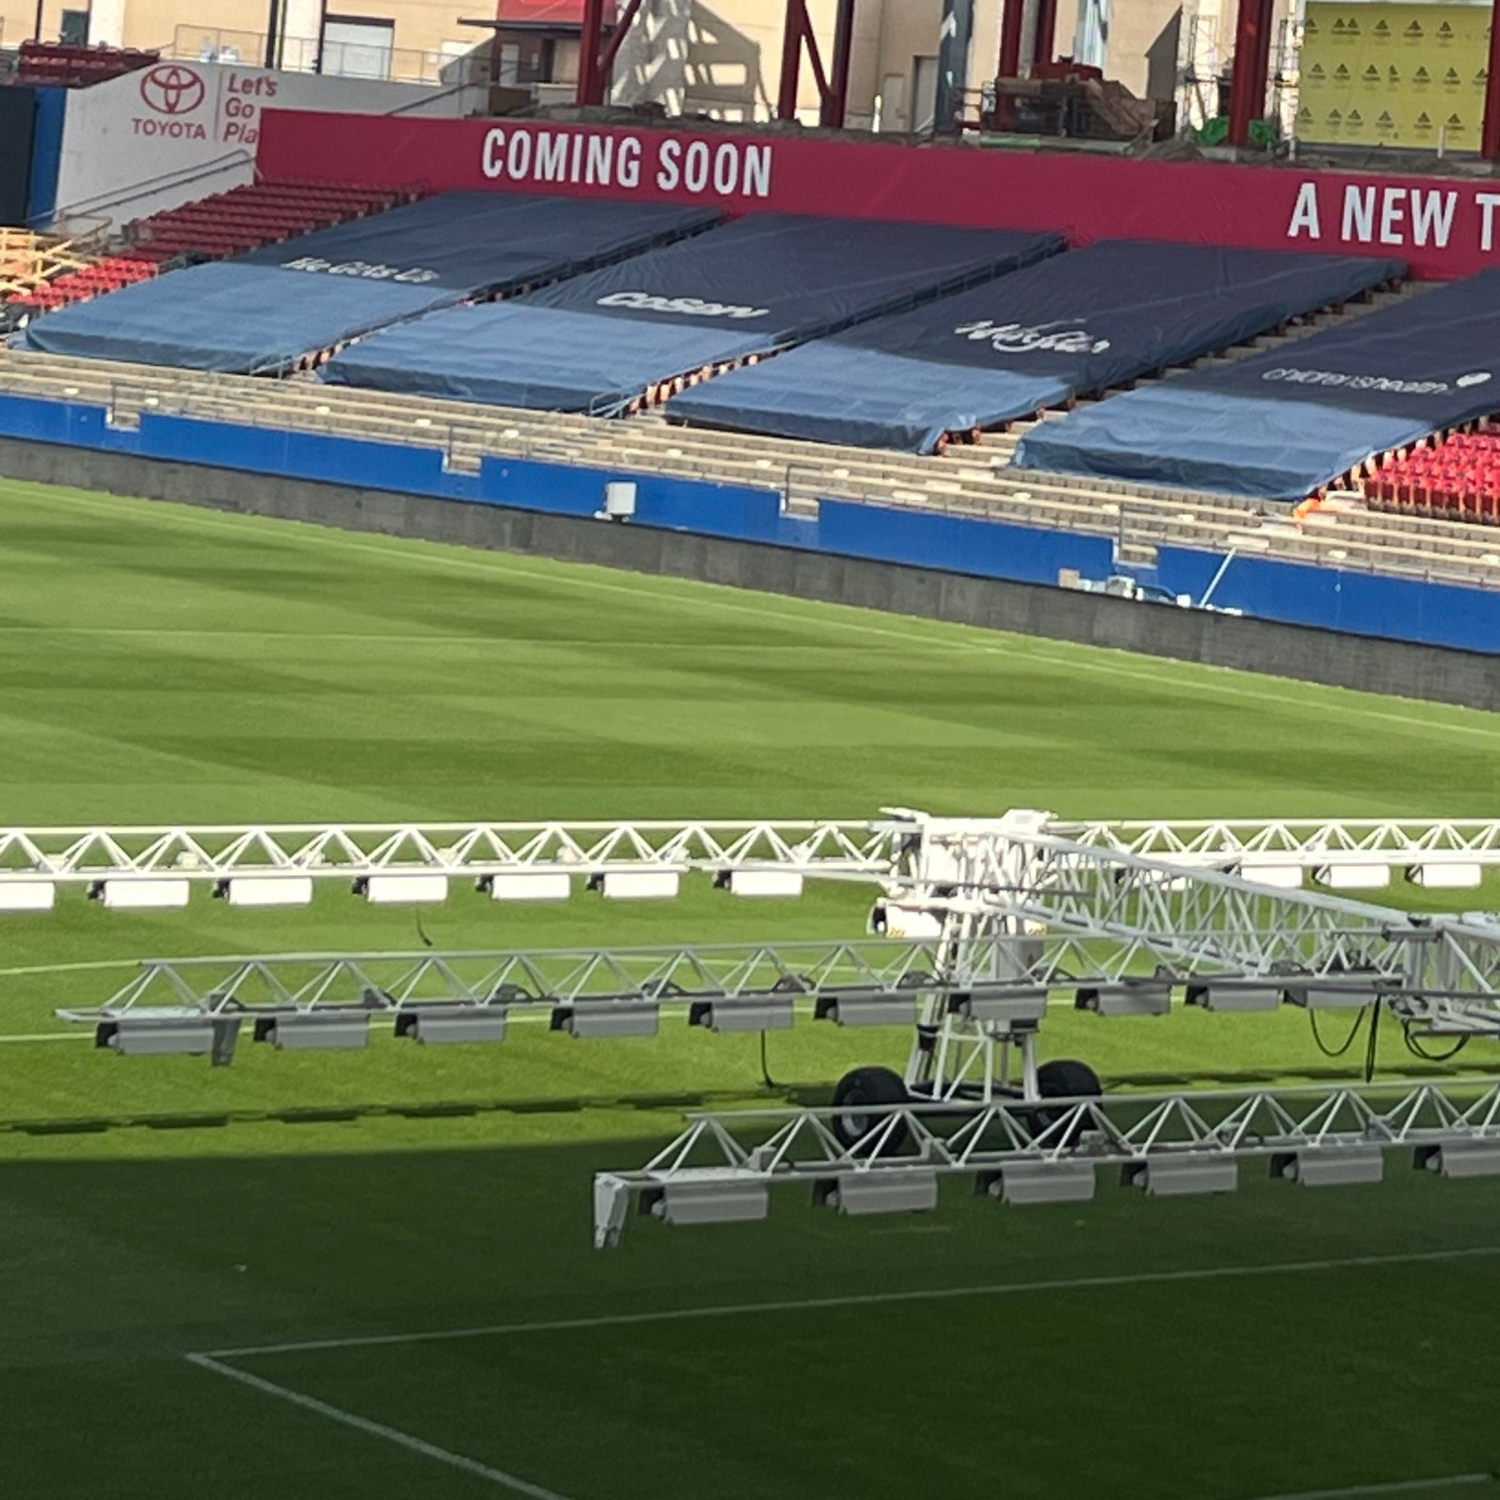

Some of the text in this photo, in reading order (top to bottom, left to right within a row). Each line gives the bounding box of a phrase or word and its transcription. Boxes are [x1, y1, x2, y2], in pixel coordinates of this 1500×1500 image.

[227, 72, 278, 97] Let's
[225, 97, 255, 118] Go
[132, 117, 206, 140] TOYOTA
[222, 122, 258, 145] Pla
[483, 129, 770, 196] COMING SOON
[1288, 183, 1319, 238] A
[1342, 186, 1457, 247] NEW
